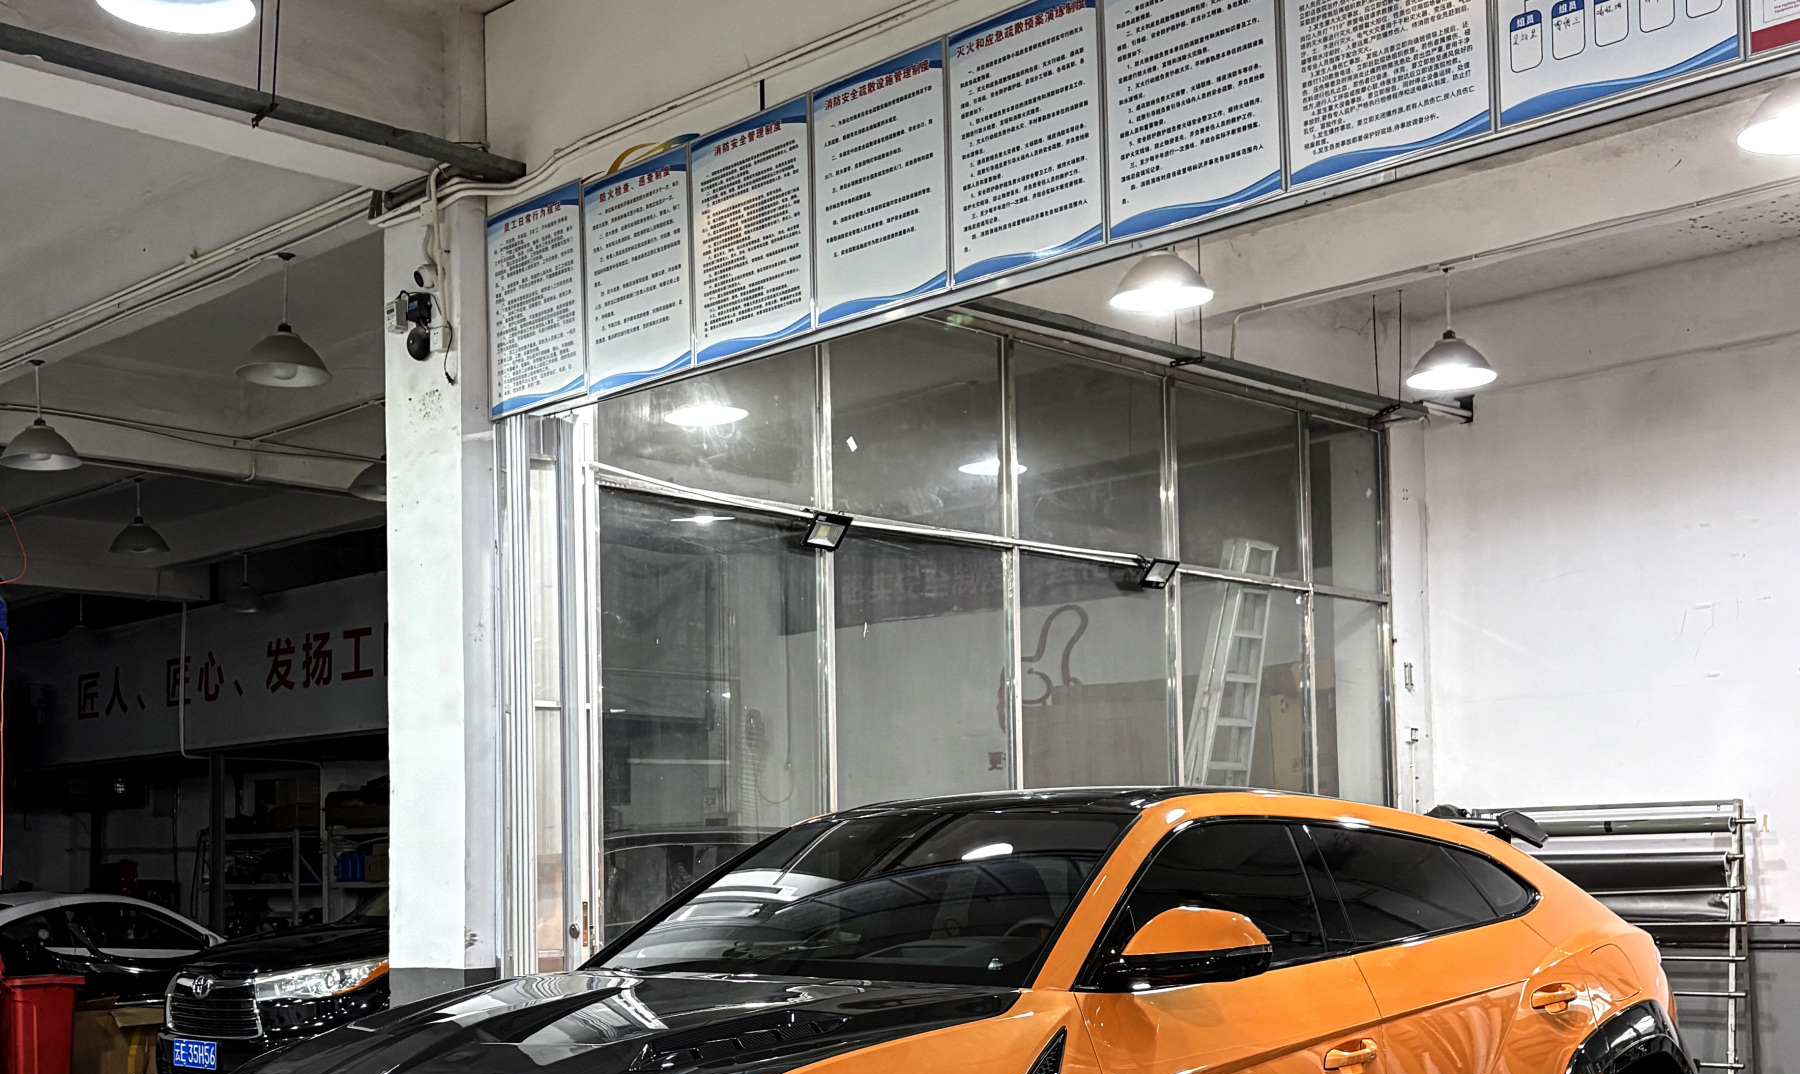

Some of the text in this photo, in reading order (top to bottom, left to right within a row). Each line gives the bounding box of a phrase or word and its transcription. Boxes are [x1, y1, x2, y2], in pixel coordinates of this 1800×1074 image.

[956, 0, 1085, 59] 灭火和应急疏散预案演练制度
[1516, 14, 1535, 28] 组员
[1558, 1, 1577, 14] 组员
[825, 58, 929, 111] 消防安全疏散设施管理制度
[714, 119, 781, 157] 消防安全管理制度
[77, 622, 388, 720] 匠人、匠心、发扬工
